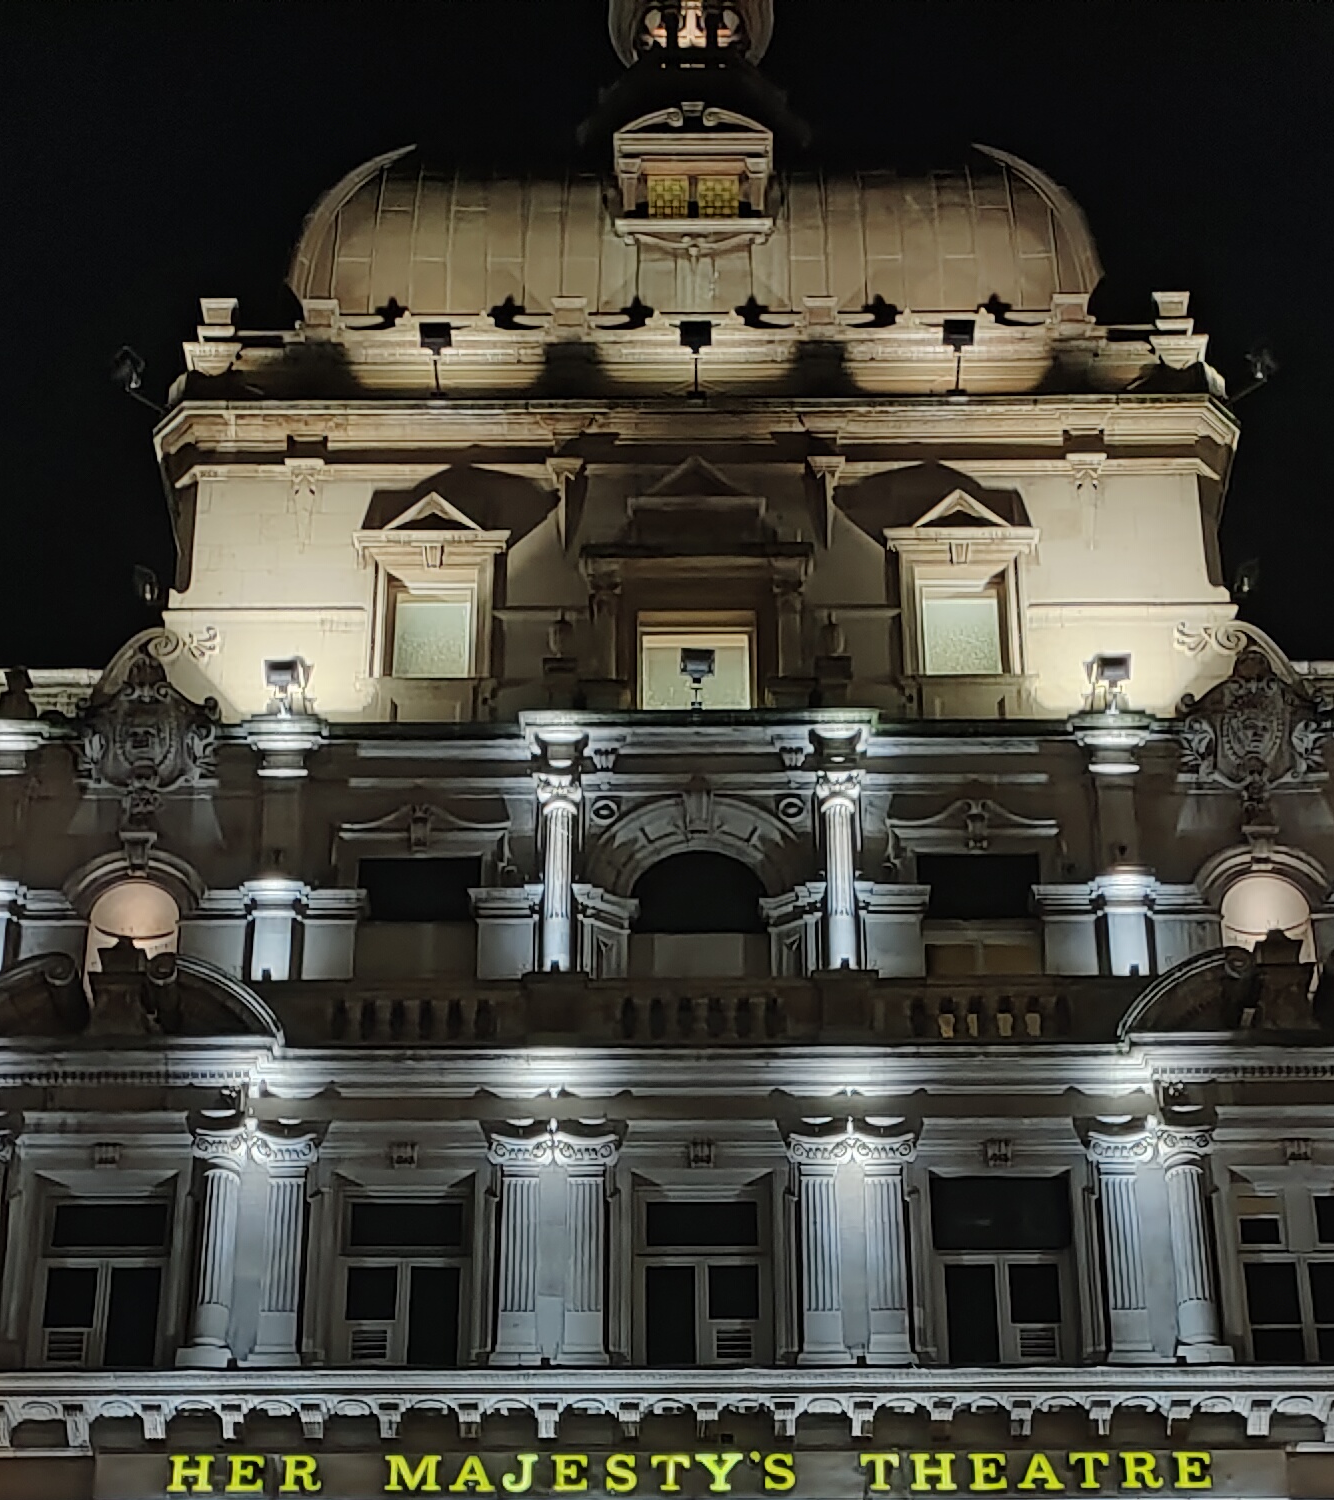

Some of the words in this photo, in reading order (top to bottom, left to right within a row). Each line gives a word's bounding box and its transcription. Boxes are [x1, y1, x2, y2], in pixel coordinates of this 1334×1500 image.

[166, 1455, 322, 1492] HER
[384, 1450, 797, 1492] MAJESTY'S
[859, 1451, 1213, 1491] THEATRE
